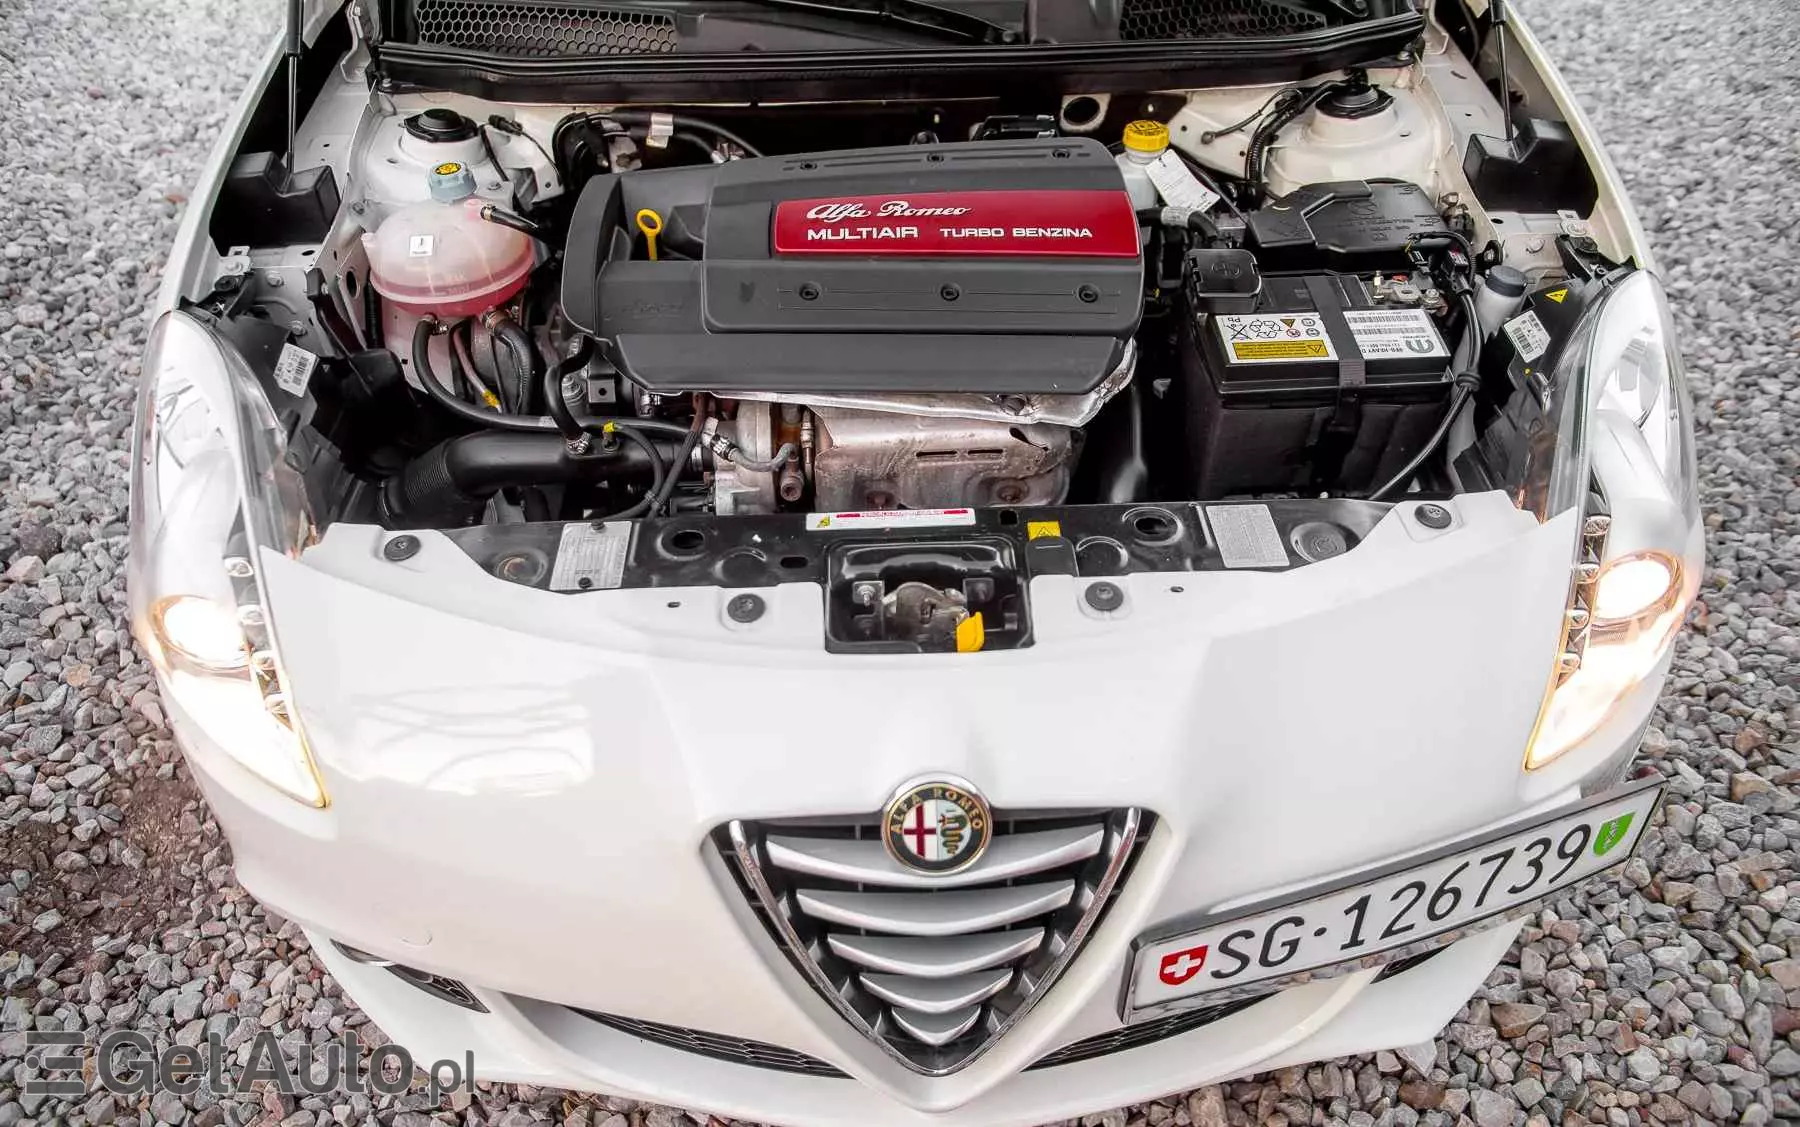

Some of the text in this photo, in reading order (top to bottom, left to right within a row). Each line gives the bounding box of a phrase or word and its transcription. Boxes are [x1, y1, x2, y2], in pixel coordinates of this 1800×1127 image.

[806, 201, 973, 223] Alfa Romeo
[807, 226, 1093, 241] MULTIAIR TURBO BENZINA
[890, 787, 984, 833] ALFA ROMEO
